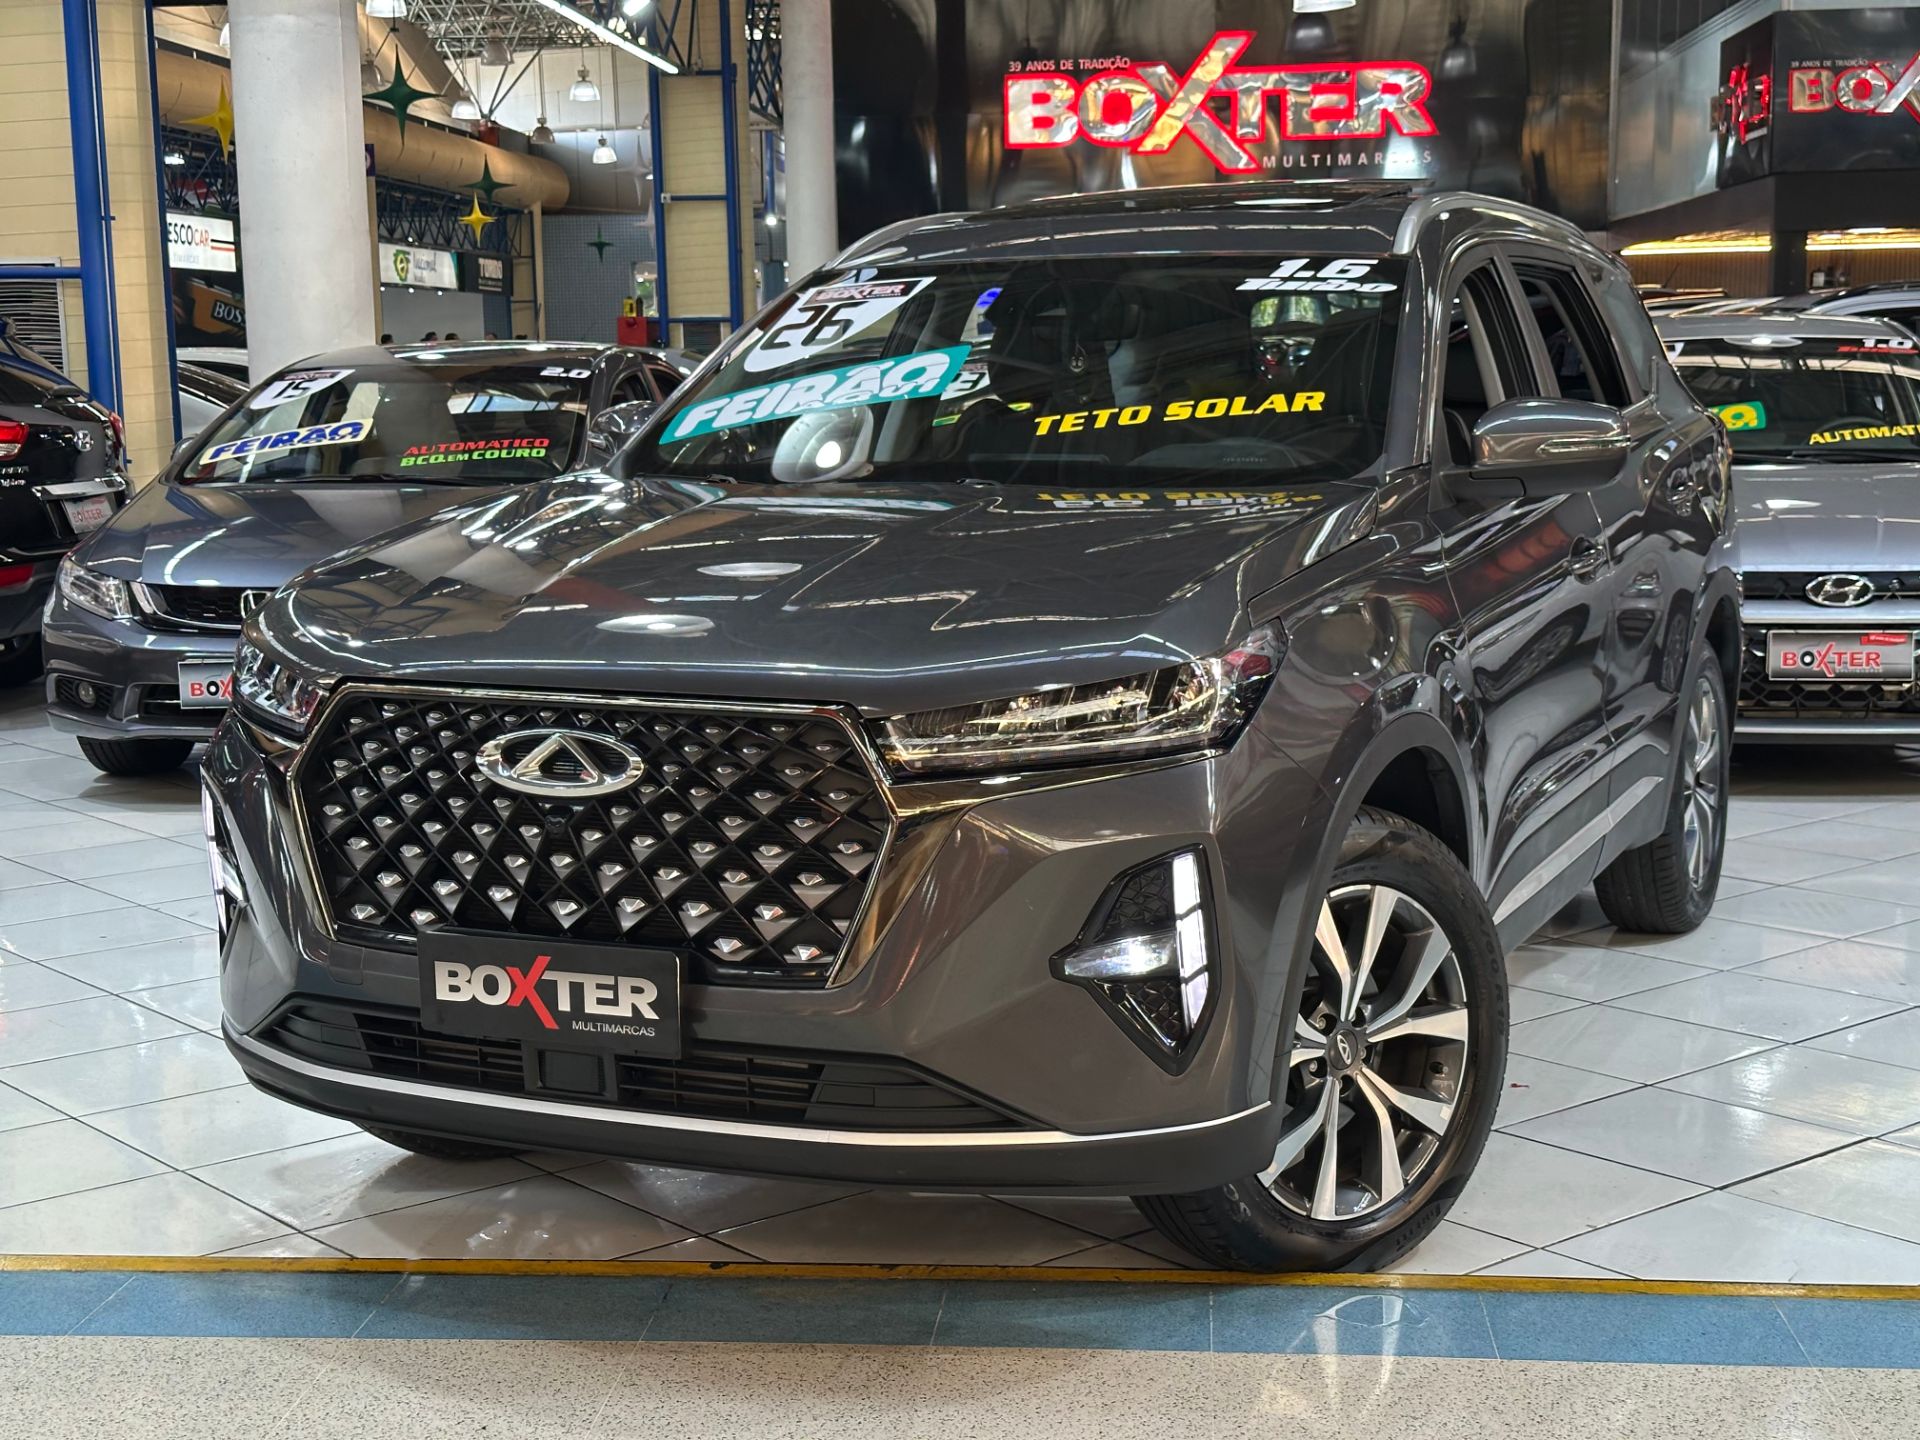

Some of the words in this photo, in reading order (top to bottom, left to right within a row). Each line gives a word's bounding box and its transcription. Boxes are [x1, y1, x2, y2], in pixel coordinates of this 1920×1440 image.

[1009, 61, 1021, 72] 39
[1026, 60, 1055, 71] ANOS
[1060, 59, 1074, 70] DE
[1079, 55, 1131, 70] TRADIÇÃO
[1004, 30, 1440, 175] BOXTER
[1262, 150, 1432, 168] MULTIMARS
[1269, 258, 1379, 278] 1.6
[815, 284, 905, 301] BOXTER
[214, 302, 246, 327] BOS
[760, 302, 868, 350] 26
[1863, 338, 1914, 348] 1.0
[540, 366, 591, 379] 2.0
[674, 353, 950, 437] FEIRÃO
[1034, 405, 1152, 436] TETO
[1163, 391, 1326, 422] SOLAR
[209, 421, 364, 460] FEIRÃO
[403, 438, 550, 456] AUTOMATICO
[472, 448, 546, 460] COURO
[1780, 641, 1881, 678] BOXTER
[434, 955, 660, 1030] BOXTER
[571, 1020, 656, 1037] MULTIMARCAS
